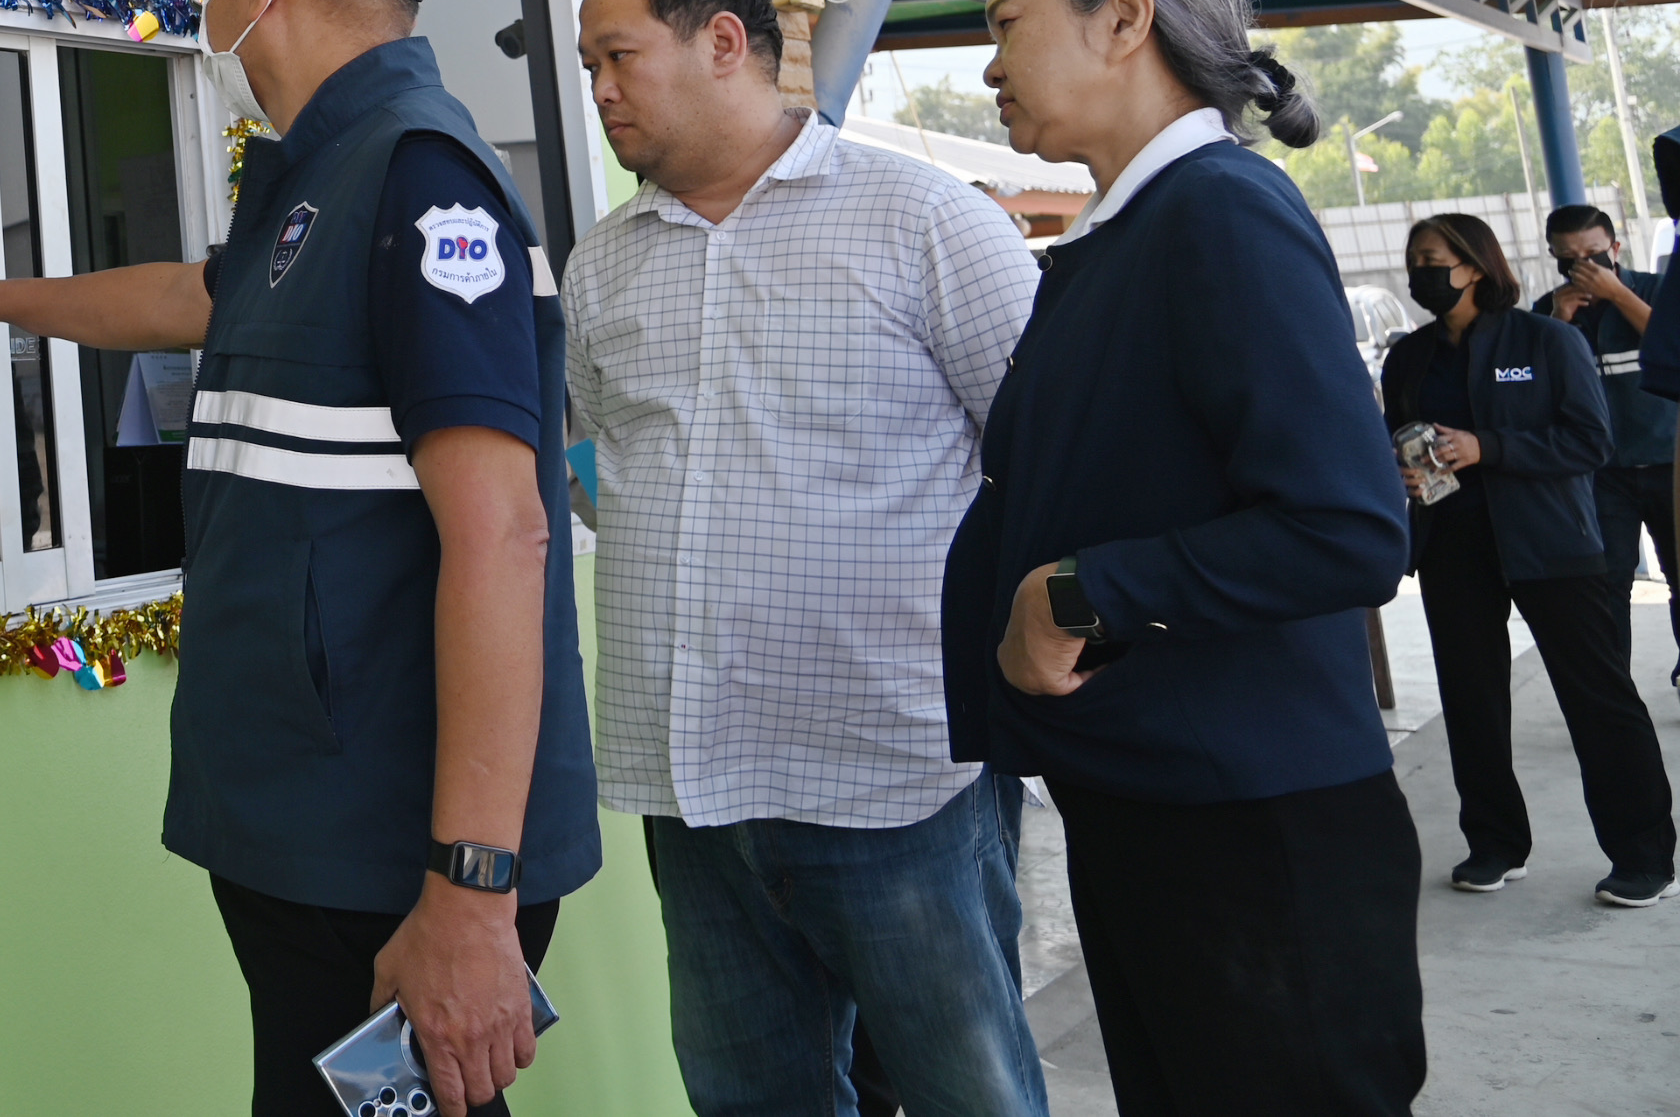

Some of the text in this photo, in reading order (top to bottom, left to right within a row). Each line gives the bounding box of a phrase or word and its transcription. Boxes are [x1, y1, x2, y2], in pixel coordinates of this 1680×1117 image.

[431, 267, 498, 284] กรมการค้าภายใน
[1494, 366, 1533, 379] MOC
